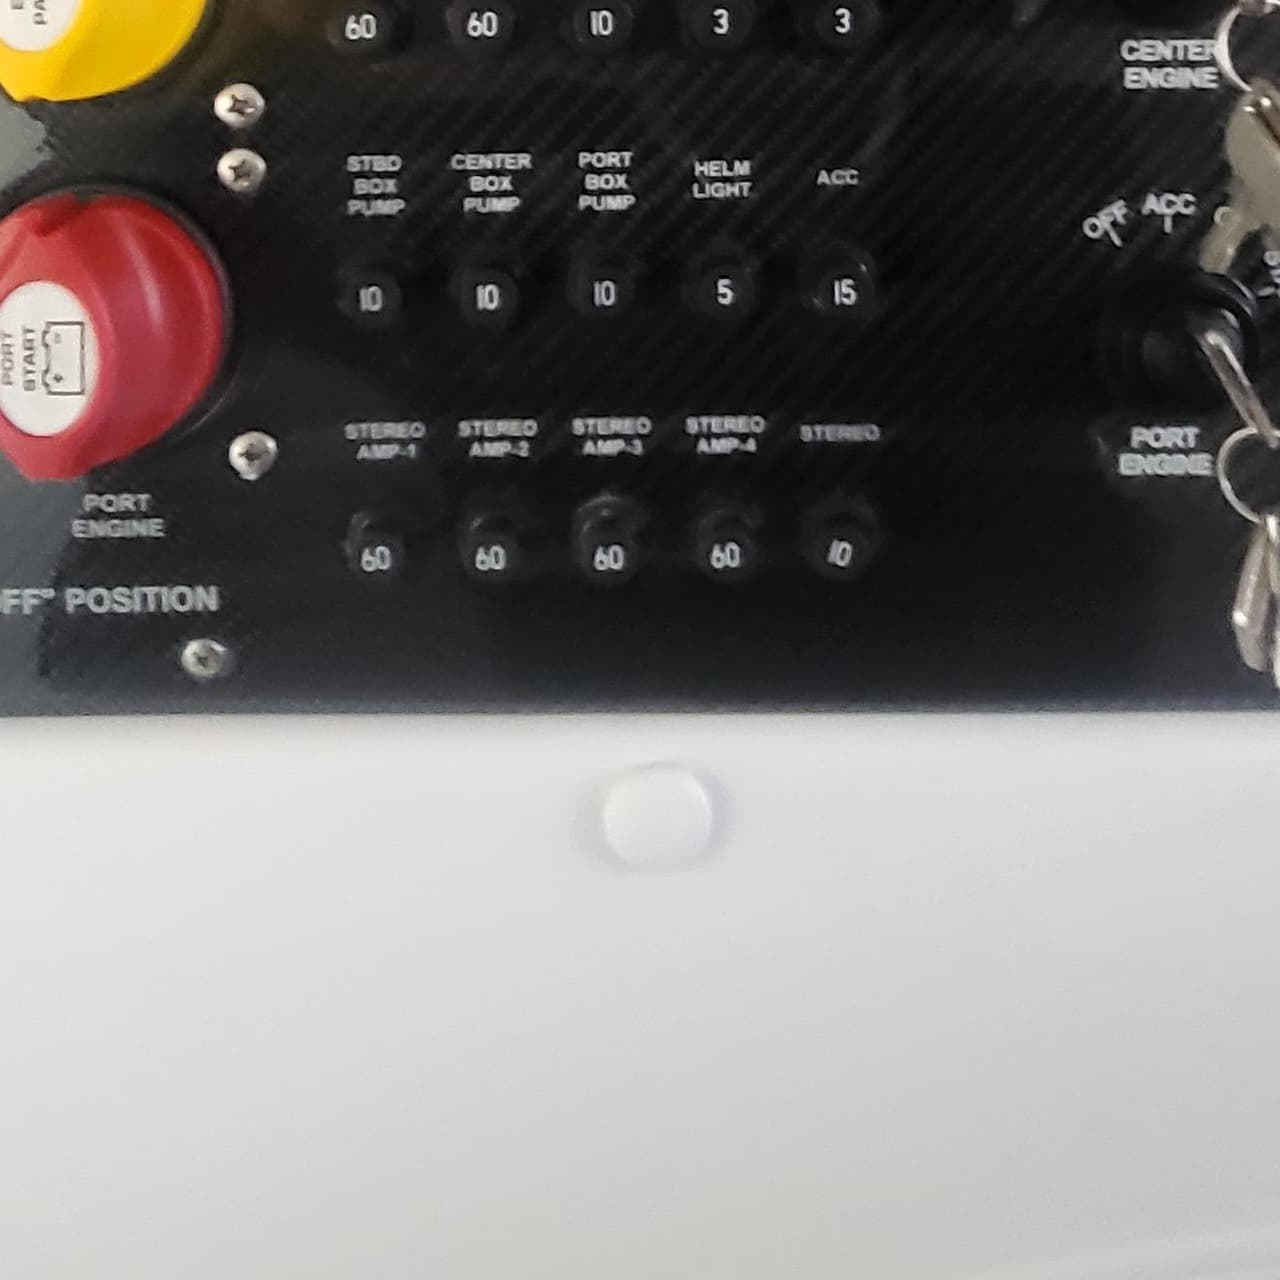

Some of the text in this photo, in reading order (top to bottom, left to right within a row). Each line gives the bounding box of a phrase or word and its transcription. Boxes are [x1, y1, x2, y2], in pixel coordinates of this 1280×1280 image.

[344, 14, 377, 39] 60
[467, 12, 498, 38] 60
[590, 10, 613, 36] 10
[713, 9, 729, 35] 3
[835, 8, 851, 34] 3
[1121, 40, 1218, 61] CENTER
[1124, 67, 1218, 89] ENGINE
[347, 154, 402, 172] STBD
[451, 153, 532, 170] CENTER
[578, 152, 633, 169] PORT
[695, 159, 751, 177] HELM
[354, 177, 398, 195] BOX
[470, 175, 513, 192] BOX
[585, 172, 629, 191] BOX
[817, 169, 859, 186] ACC
[693, 181, 752, 199] LIGHT
[348, 199, 406, 216] PUMP
[464, 196, 521, 213] PUMP
[578, 194, 636, 212] PUMP
[1141, 193, 1197, 215] ACC
[360, 286, 383, 312] 10
[476, 284, 499, 310] 10
[594, 280, 616, 306] 10
[716, 279, 734, 305] 5
[834, 280, 856, 305] 15
[1, 332, 13, 385] PORT
[23, 325, 36, 391] START
[345, 423, 426, 440] STEREO
[458, 420, 538, 438] STEREO
[572, 417, 652, 436] STEREO
[685, 416, 766, 434] STEREO
[799, 424, 881, 442] STEREO
[582, 438, 644, 456] AMP-3
[696, 437, 757, 454] AMP-4
[1131, 426, 1200, 448] PORT
[356, 443, 417, 460] AMP-1
[469, 441, 529, 458] AMP-2
[1119, 453, 1215, 476] ENGINE
[82, 494, 152, 512] PORT
[72, 519, 166, 538] ENGINE
[361, 546, 391, 572] 60
[475, 545, 506, 571] 60
[594, 545, 624, 571] 60
[711, 542, 740, 568] 60
[828, 539, 853, 566] 10
[66, 585, 218, 613] POSITION
